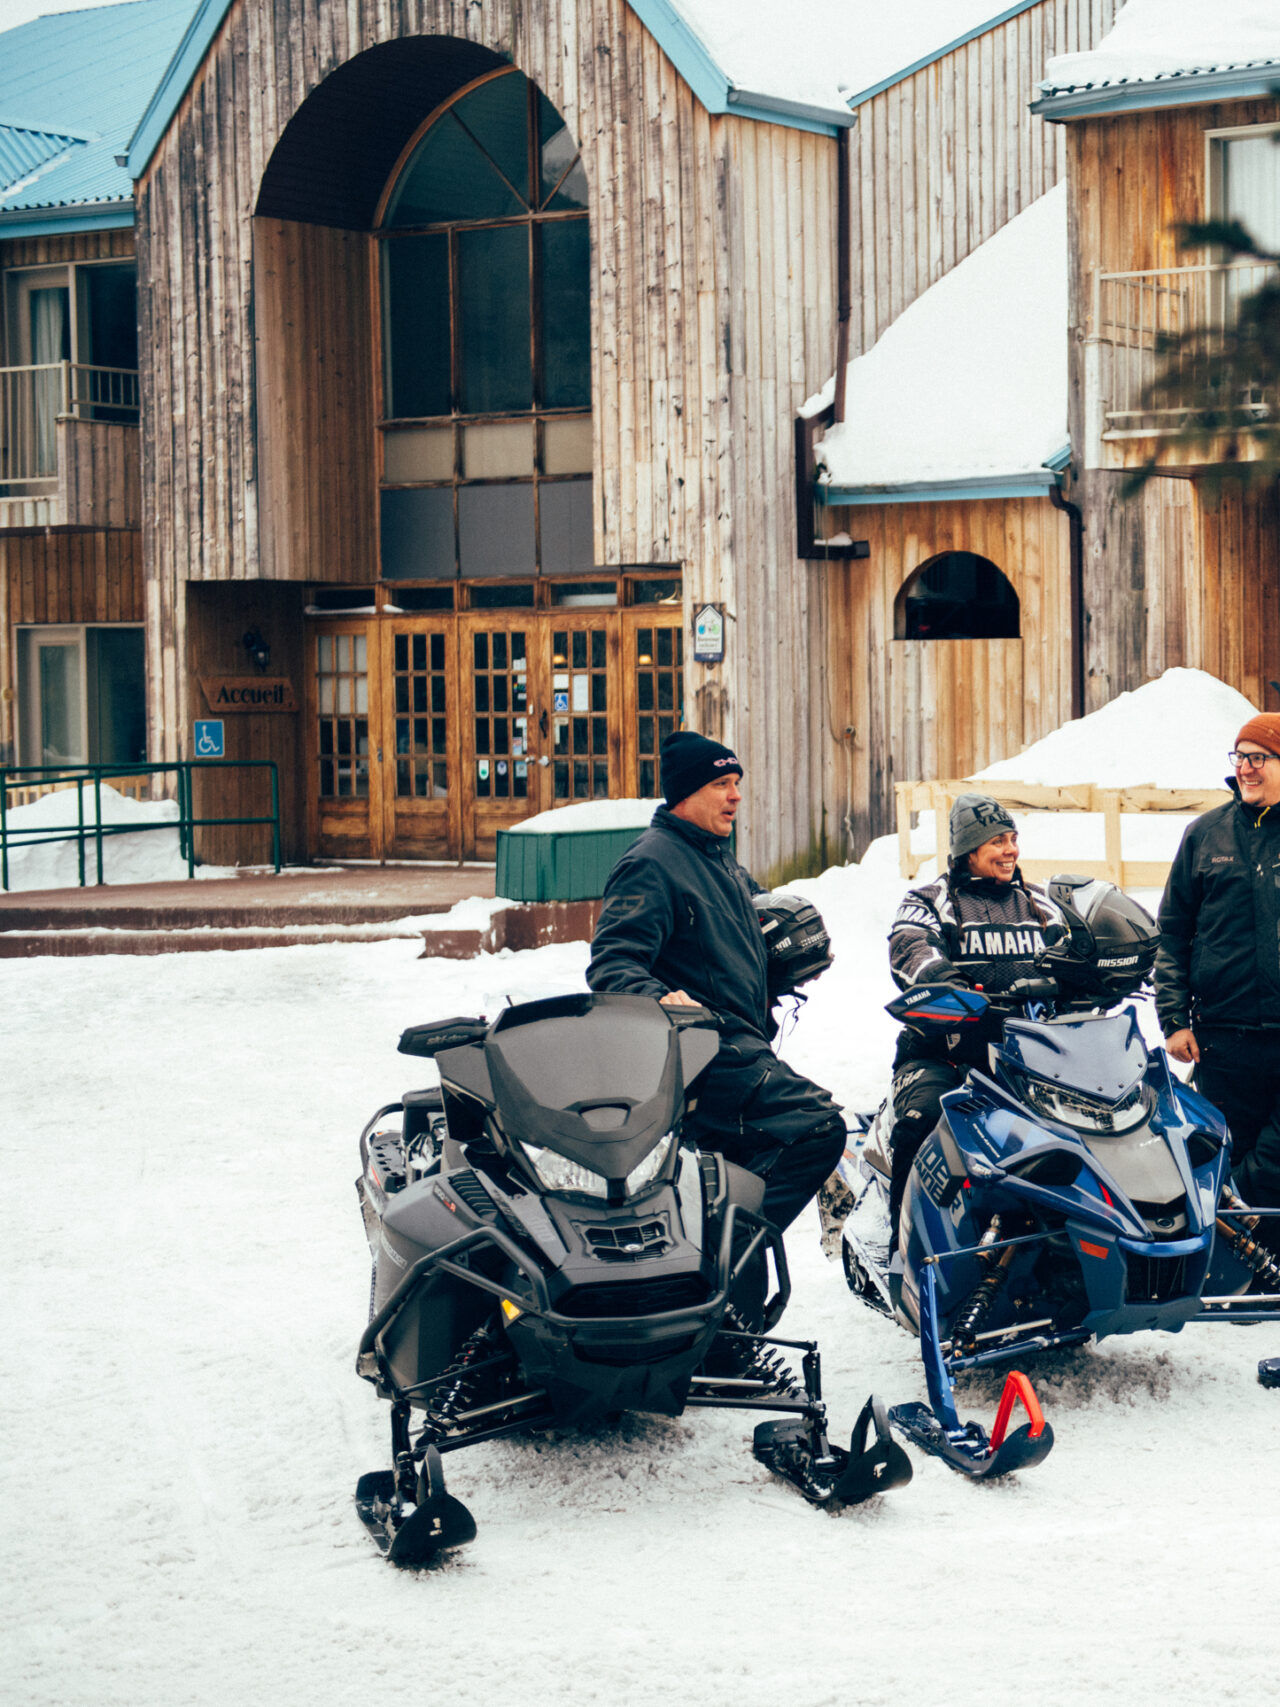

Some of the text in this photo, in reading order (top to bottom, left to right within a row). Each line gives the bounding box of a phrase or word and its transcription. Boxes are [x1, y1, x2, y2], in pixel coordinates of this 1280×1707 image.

[216, 684, 284, 704] Accueil
[959, 930, 1046, 955] YAMAHA
[904, 989, 931, 1006] YAMAHA
